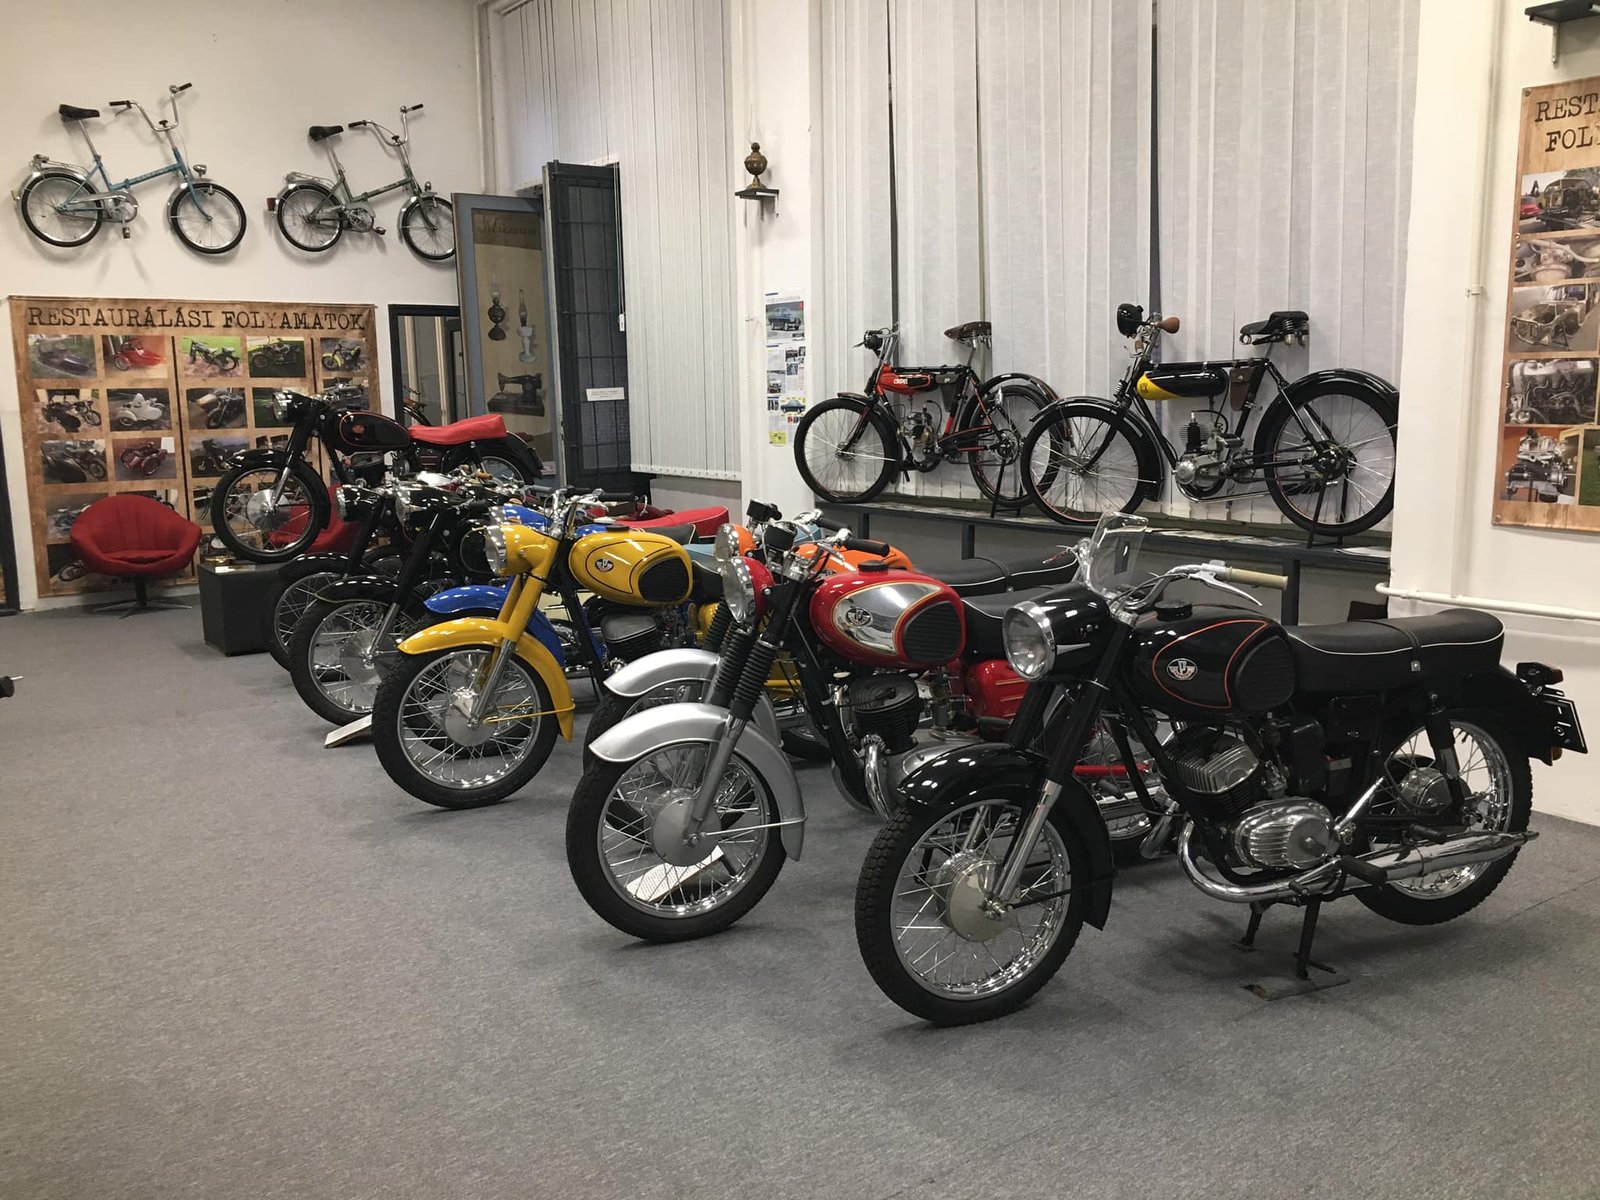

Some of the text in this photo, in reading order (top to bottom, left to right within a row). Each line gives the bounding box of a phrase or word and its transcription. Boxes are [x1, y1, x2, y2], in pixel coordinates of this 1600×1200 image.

[1534, 92, 1600, 122] REST
[28, 306, 366, 331] RESTAURÁLÁSI FOLYAMATOK
